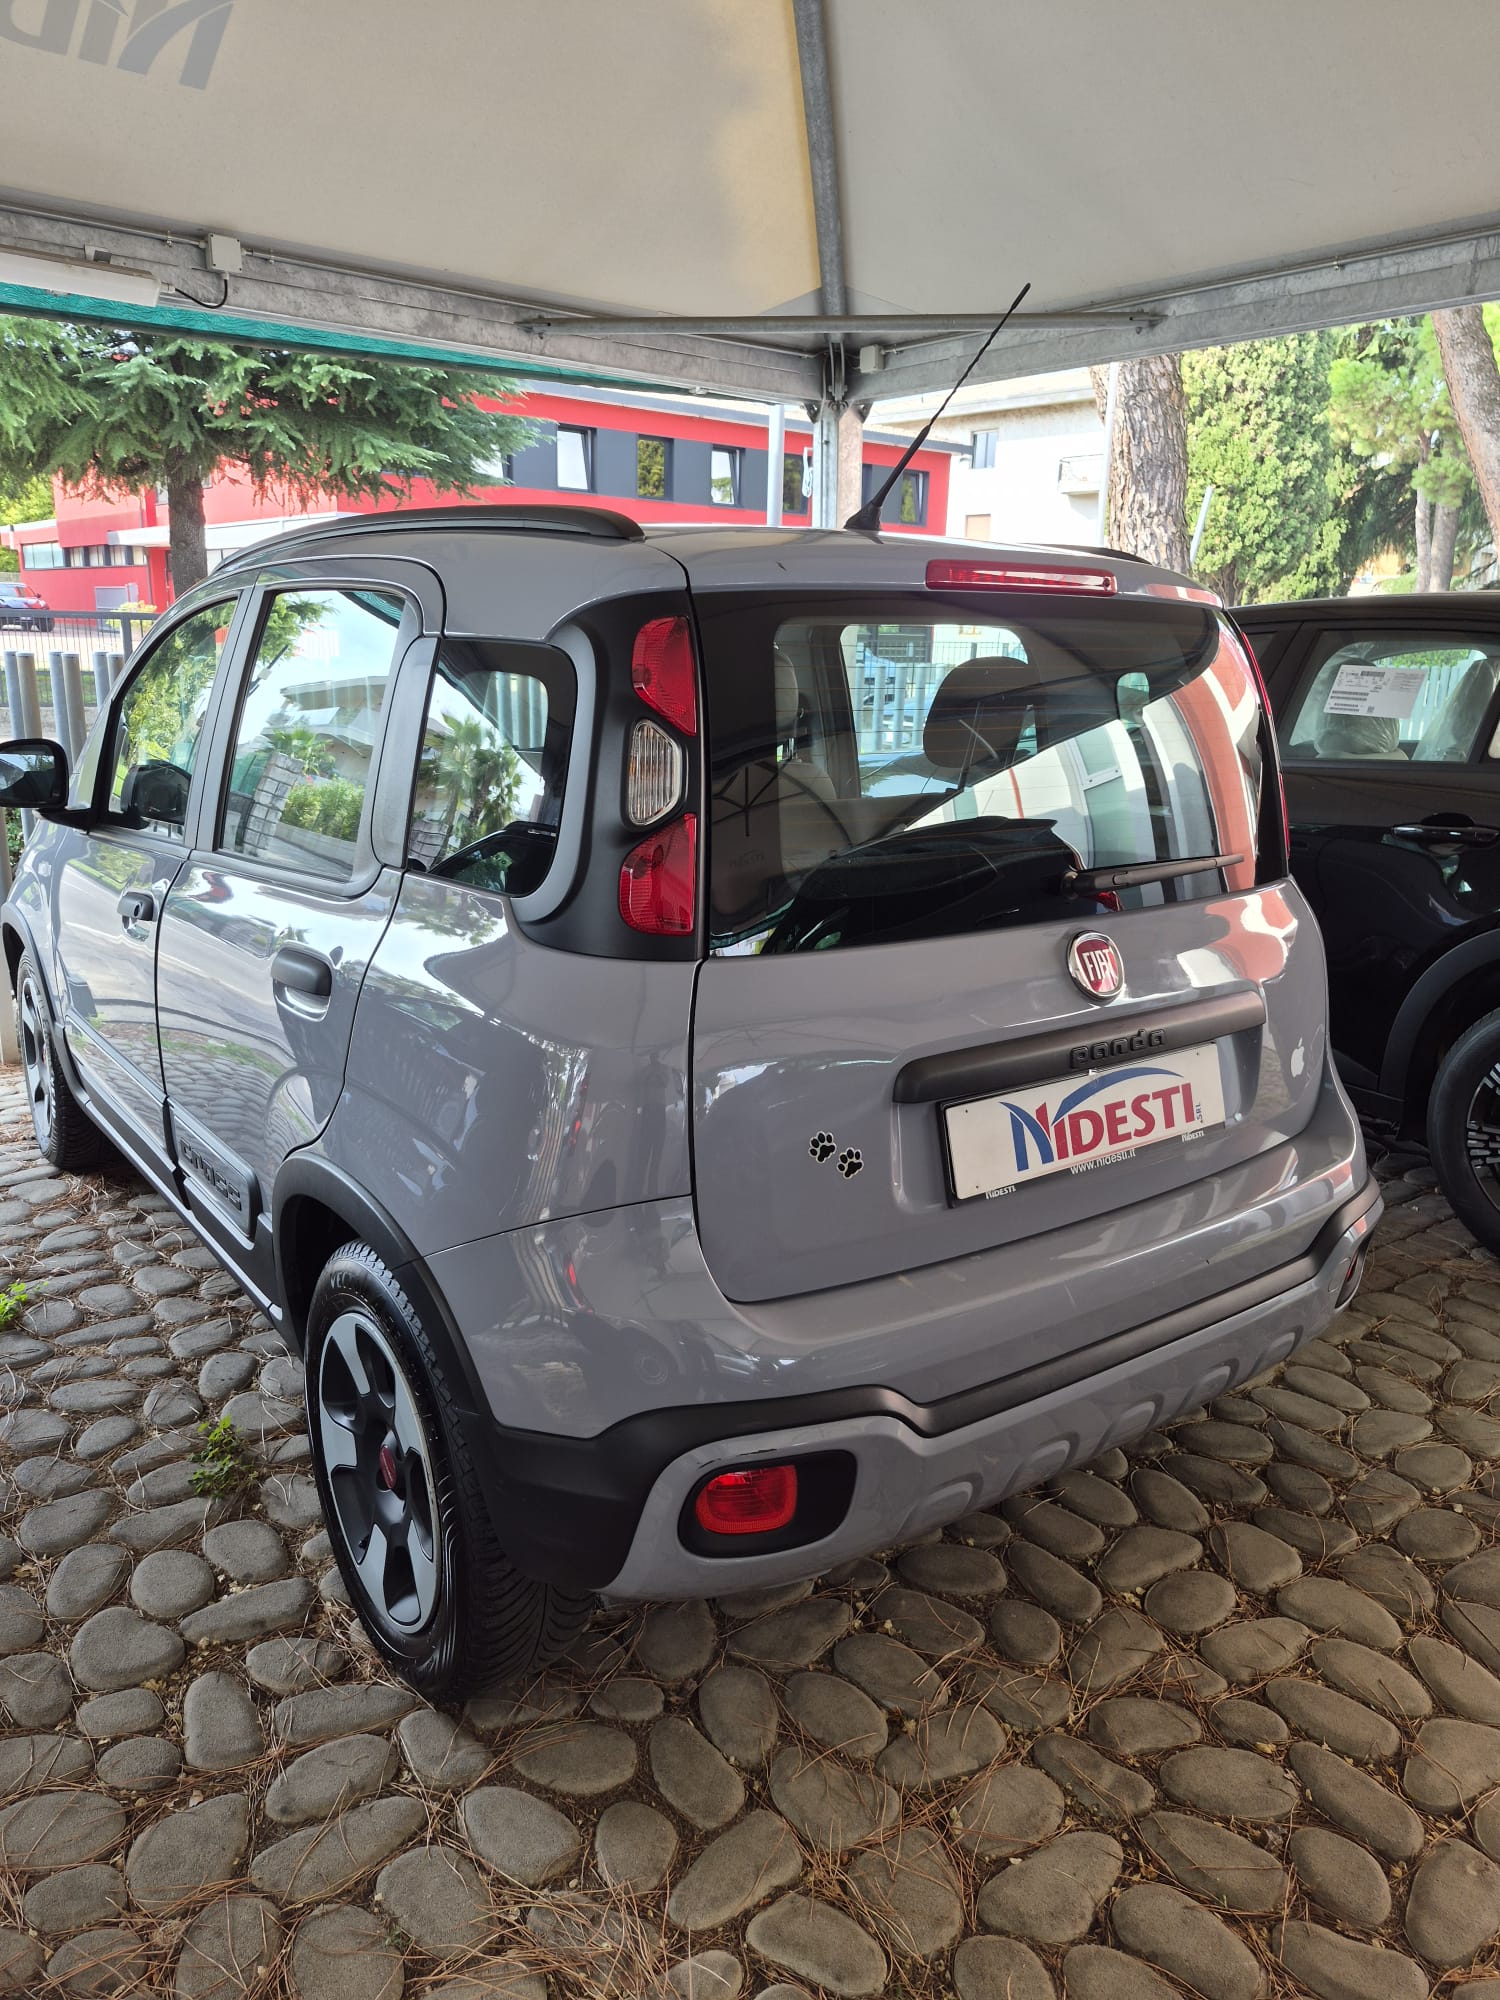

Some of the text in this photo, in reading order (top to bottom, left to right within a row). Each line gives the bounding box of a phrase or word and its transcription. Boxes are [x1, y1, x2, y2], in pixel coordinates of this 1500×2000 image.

[1082, 947, 1116, 982] FIAT
[1070, 1028, 1166, 1069] panda
[1000, 1082, 1196, 1172] NIDESTI
[1070, 1149, 1137, 1175] www.nidesti.it
